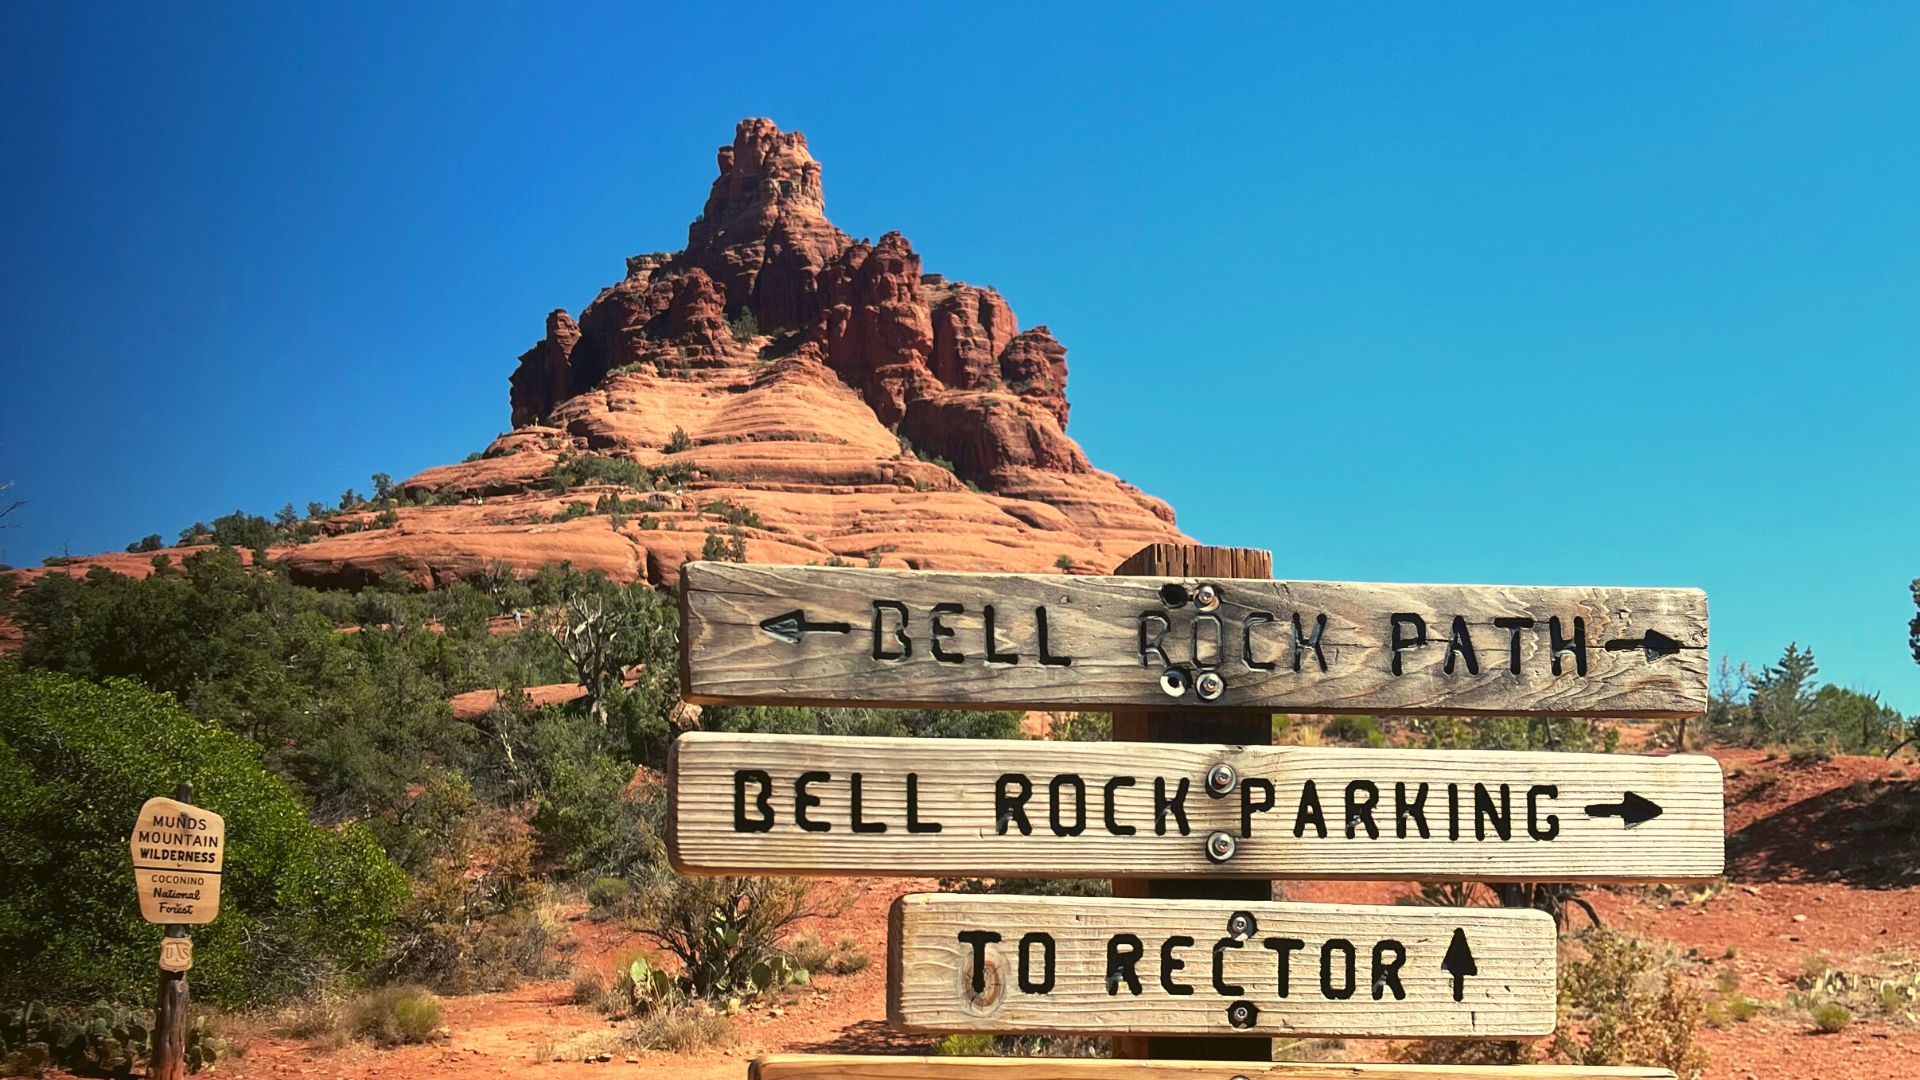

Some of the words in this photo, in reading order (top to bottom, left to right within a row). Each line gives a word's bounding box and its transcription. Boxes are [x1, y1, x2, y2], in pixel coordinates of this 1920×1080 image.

[873, 599, 1072, 666] BELL
[1138, 610, 1327, 673] ROCK
[1390, 612, 1587, 677] PATH
[734, 769, 943, 833] BELL
[995, 773, 1191, 836] ROCK
[1240, 777, 1560, 841] PARKING
[153, 815, 207, 830] MUNDS
[139, 831, 218, 848] MOUNTAIN
[140, 848, 216, 863] WILDERNESS
[152, 874, 204, 886] COCONINO
[153, 887, 201, 900] National
[158, 902, 194, 915] Forest
[958, 930, 1056, 995] TO
[1105, 932, 1408, 1001] RECTOR
